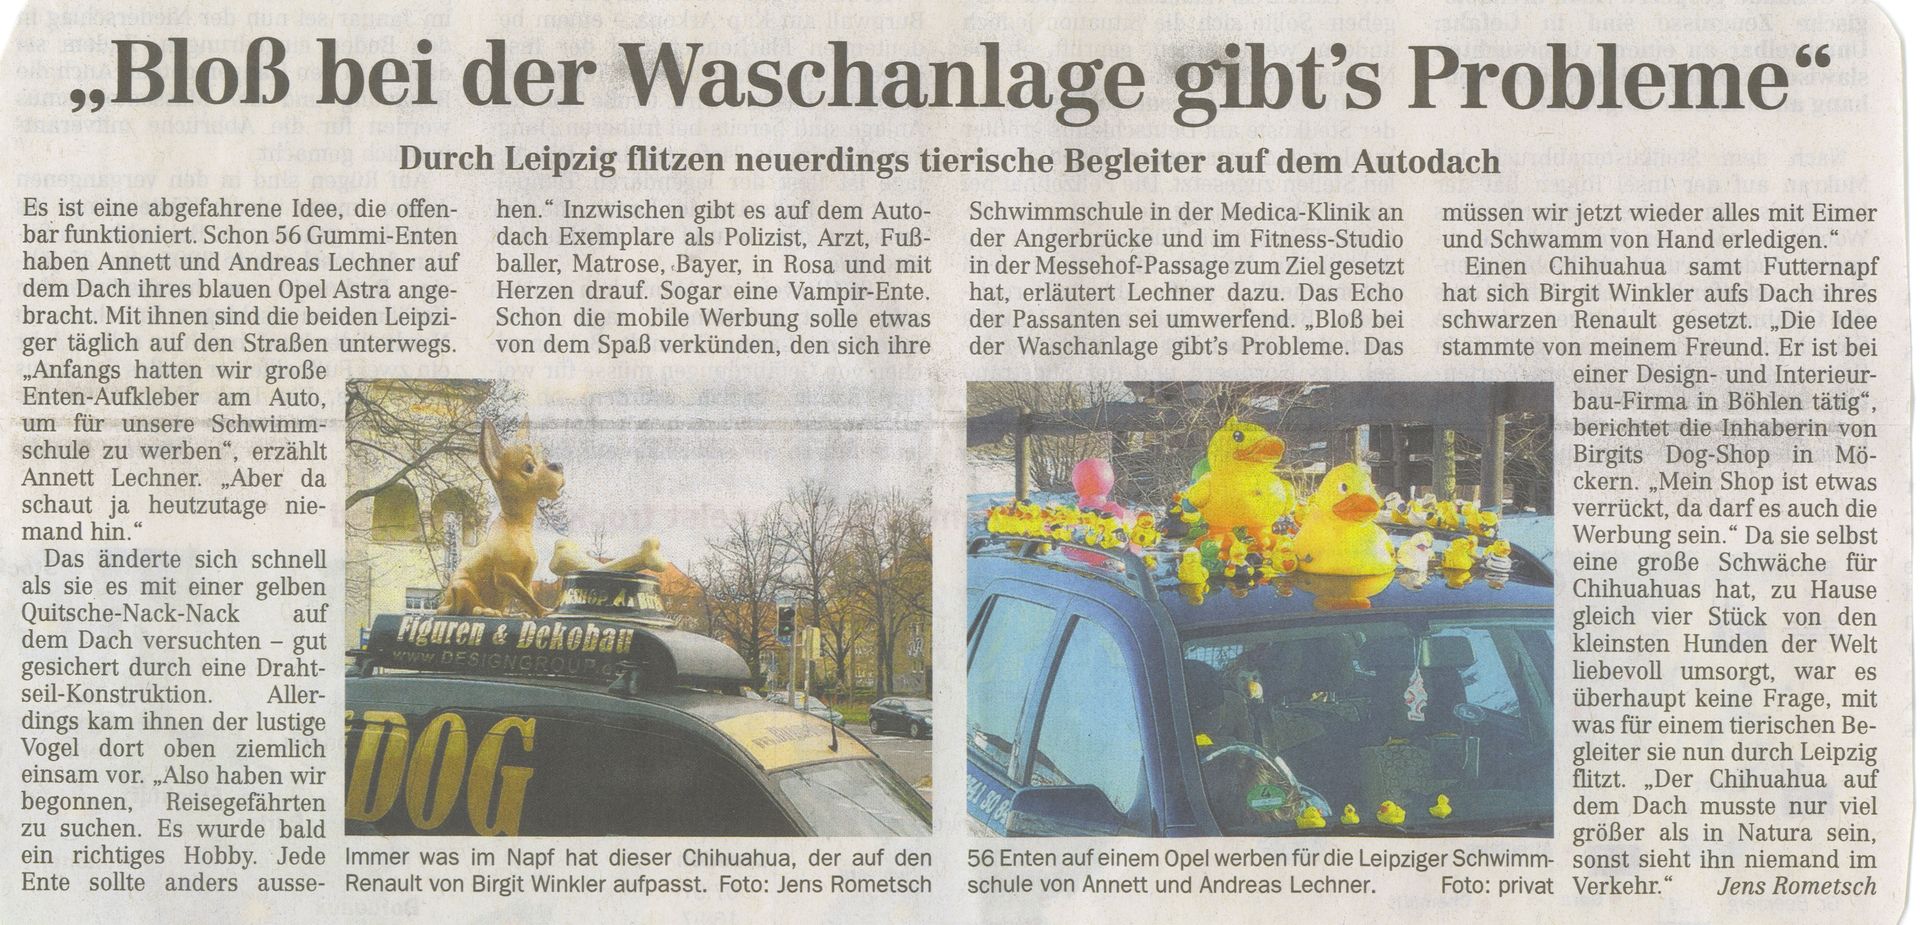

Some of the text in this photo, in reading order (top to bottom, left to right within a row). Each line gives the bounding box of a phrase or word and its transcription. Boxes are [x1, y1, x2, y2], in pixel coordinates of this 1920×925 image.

[316, 38, 438, 106] bei
[463, 39, 596, 106] der
[618, 41, 1145, 127] Waschanlage
[400, 144, 1500, 180] Durch Leipzig flitzen neuerdings tierische Begleiter auf dem Autodach
[24, 197, 457, 222] Es ist eine abgefahrene Idee, die offen-
[970, 201, 1404, 221] Schwimmschule in der Medica-Klinik an
[497, 226, 930, 250] dach Exemplare als Polizist, Arzt, Fuß-
[23, 251, 460, 272] haben Annett und Andreas Lechner auf
[1466, 256, 1880, 280] Einen Chihuahua samt Futternapf
[497, 280, 929, 306] Herzen drauf. Sogar eine Vampir-Ente.
[1443, 309, 1557, 328] schwarzen
[1574, 310, 1656, 328] Renault
[1673, 312, 1752, 334] gesetzt.
[1832, 310, 1877, 329] Idee
[22, 332, 456, 358] ger täglich auf den Straßen unterwegs.
[970, 336, 1004, 355] der
[1018, 336, 1158, 360] Waschanlage
[1242, 336, 1348, 355] Probleme.
[1364, 337, 1403, 356] Das
[1574, 364, 1876, 388] einer Design- und Interieur-
[23, 386, 326, 409] Enten-Aufkleber am Auto,
[1574, 444, 1876, 468] Birgits Dog-Shop in Mö-
[22, 468, 94, 486] Annett
[112, 468, 201, 486] Lechner.
[302, 468, 326, 487] da
[1573, 578, 1876, 601] Chihuahuas hat, zu Hause
[22, 600, 329, 625] Quitsche-Nack-Nack auf
[397, 615, 486, 646] Figuren
[516, 620, 634, 653] Dekobau
[22, 681, 325, 704] seil-Konstruktion. Aller-
[1572, 688, 1877, 712] überhaupt keine Frage, mit
[345, 710, 536, 837] DOG
[22, 790, 326, 816] begonnen, Reisegefährten
[1573, 822, 1876, 846] größer als in Natura sein,
[346, 848, 931, 870] Immer was im Napf hat dieser Chihuahua, der auf den
[968, 848, 1554, 872] 56 Enten auf einem Opel werben für die Leipziger Schwimm-
[22, 872, 324, 892] Ente sollte anders ausse-
[346, 874, 931, 896] Renault von Birgit Winkler aufpasst. Foto: Jens Rometsch
[968, 874, 1554, 898] schule von Annett und Andreas Lechner. Foto: privat
[1717, 877, 1766, 895] Jens
[1772, 876, 1876, 896] Rometsch
